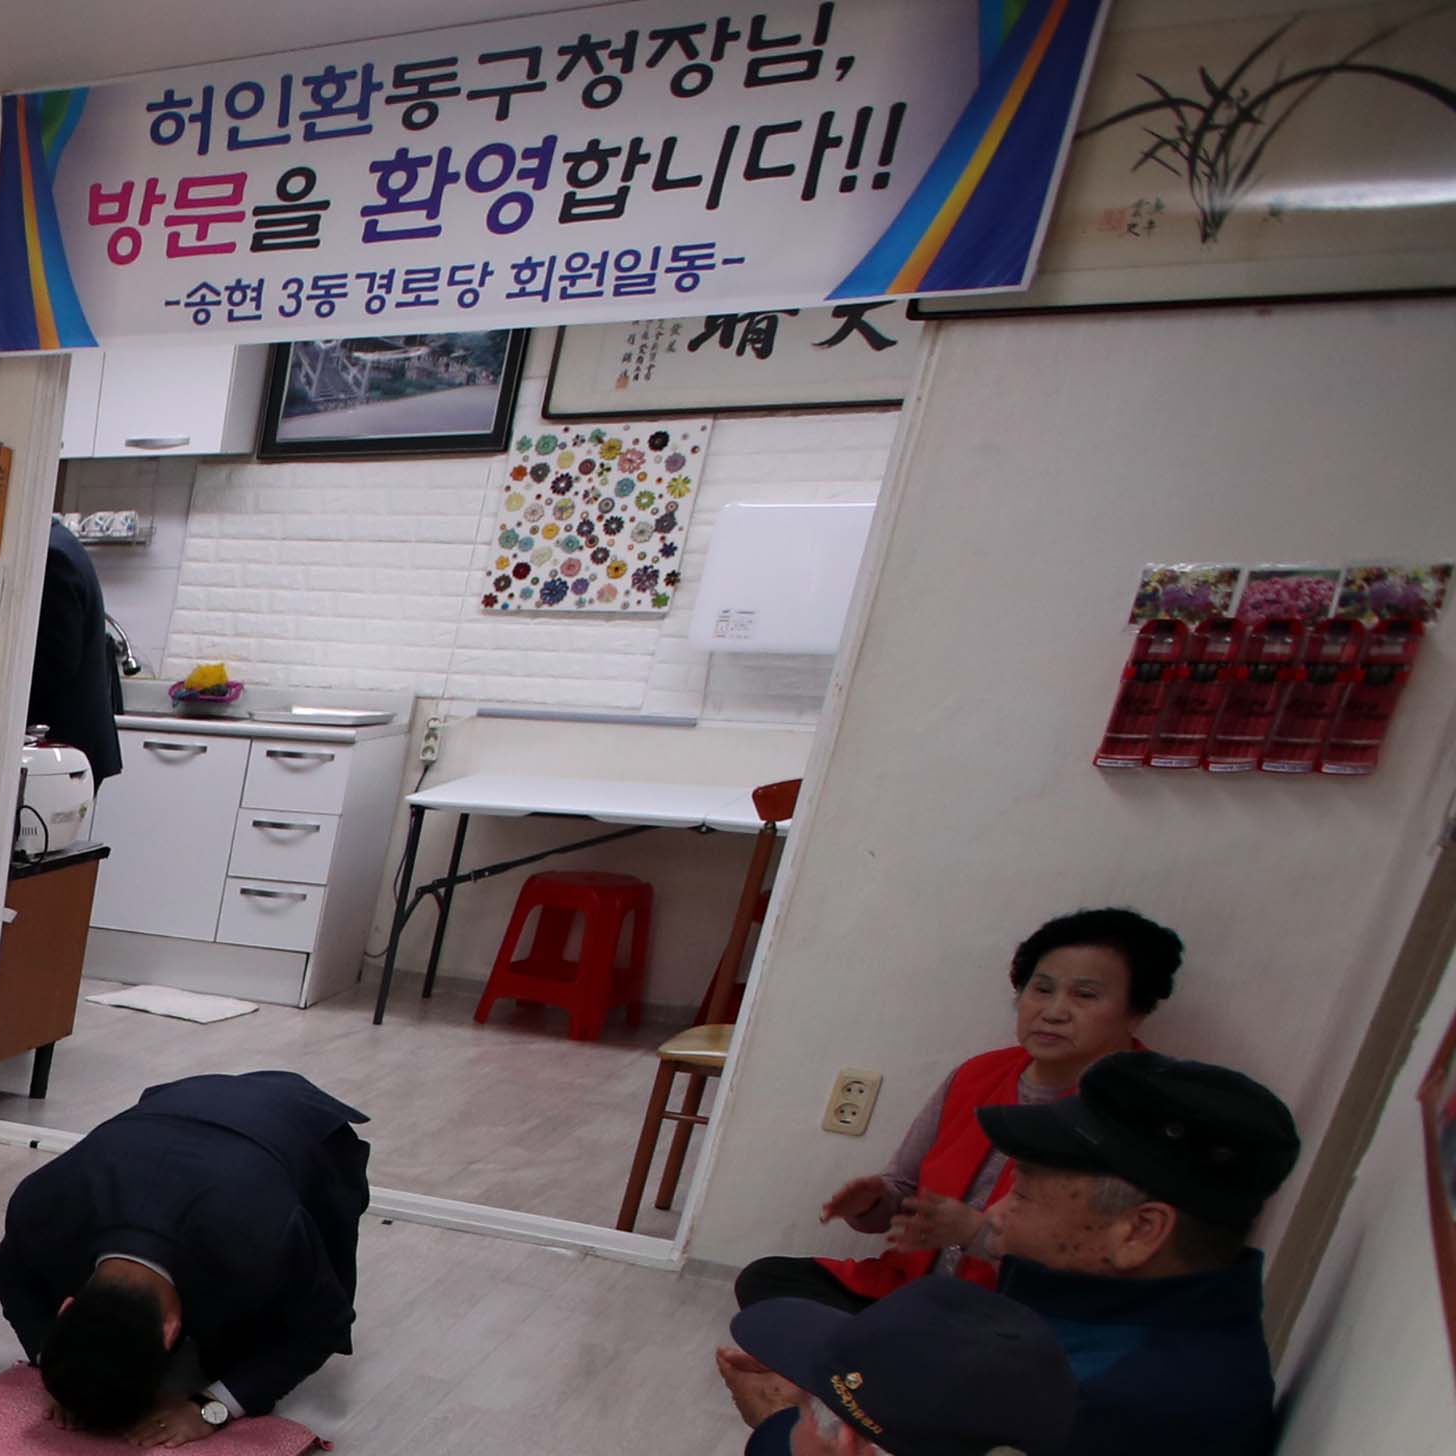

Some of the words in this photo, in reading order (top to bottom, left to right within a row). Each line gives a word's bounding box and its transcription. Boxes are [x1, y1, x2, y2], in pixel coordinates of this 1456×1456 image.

[145, 2, 856, 157] 허인환동구청장님,
[88, 167, 331, 266] 방문을
[361, 101, 908, 244] 환영합니다!!
[505, 242, 746, 302] 회원일동-
